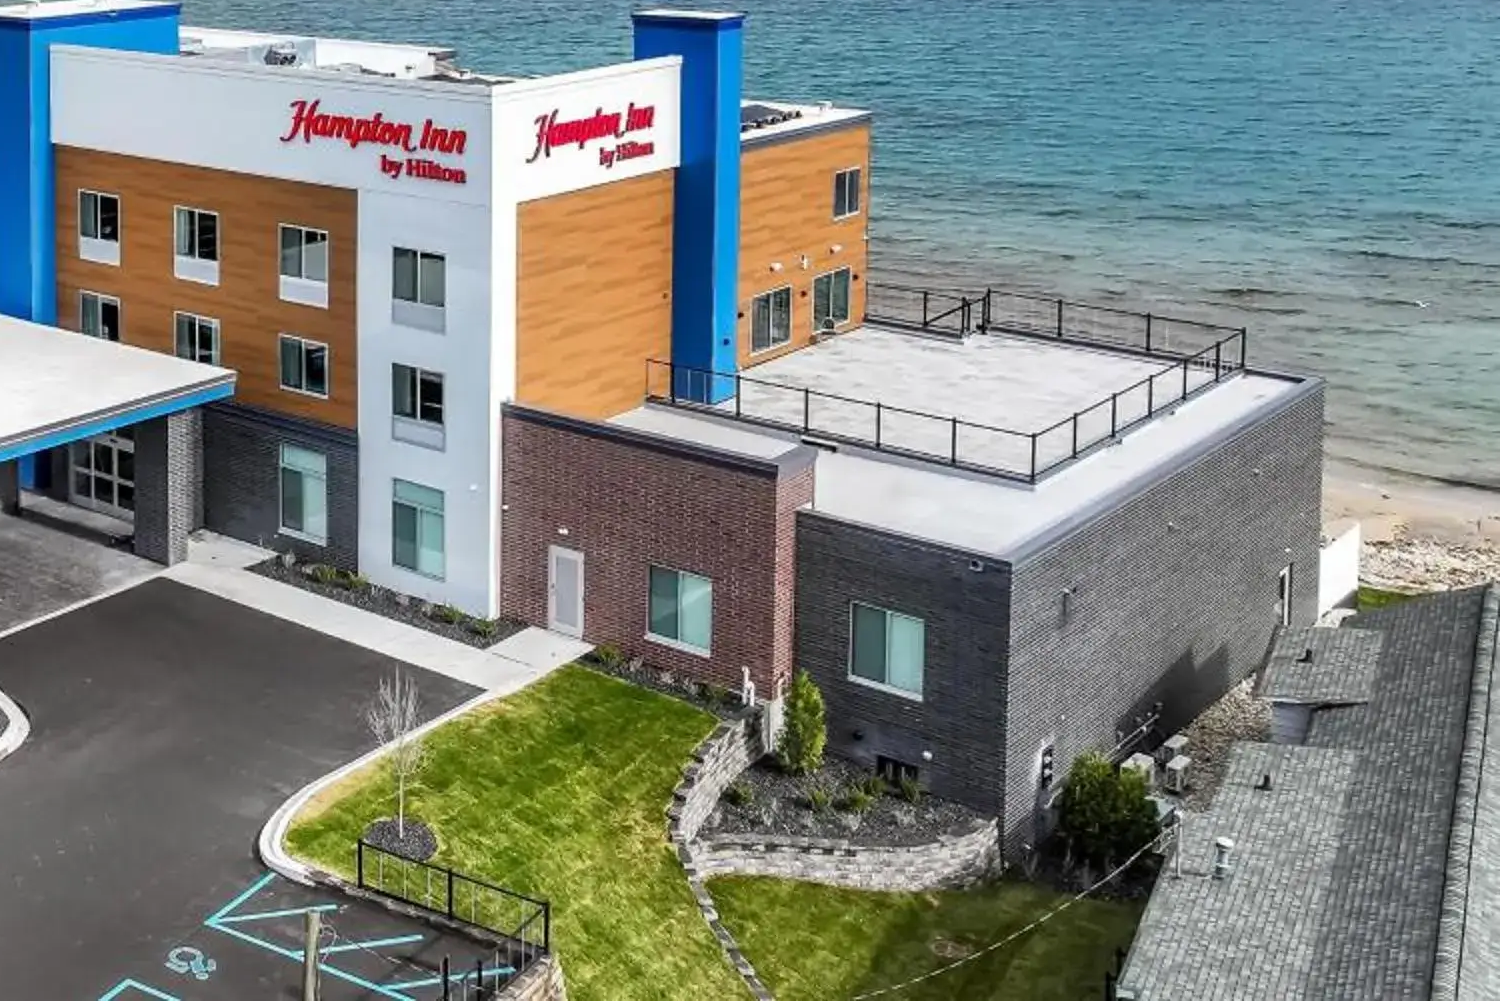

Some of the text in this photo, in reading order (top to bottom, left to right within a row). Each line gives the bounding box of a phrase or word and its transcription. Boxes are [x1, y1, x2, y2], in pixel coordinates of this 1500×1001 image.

[280, 100, 467, 155] Hampton Inn
[525, 102, 654, 163] Hampton Inn
[380, 154, 467, 184] by Hilton
